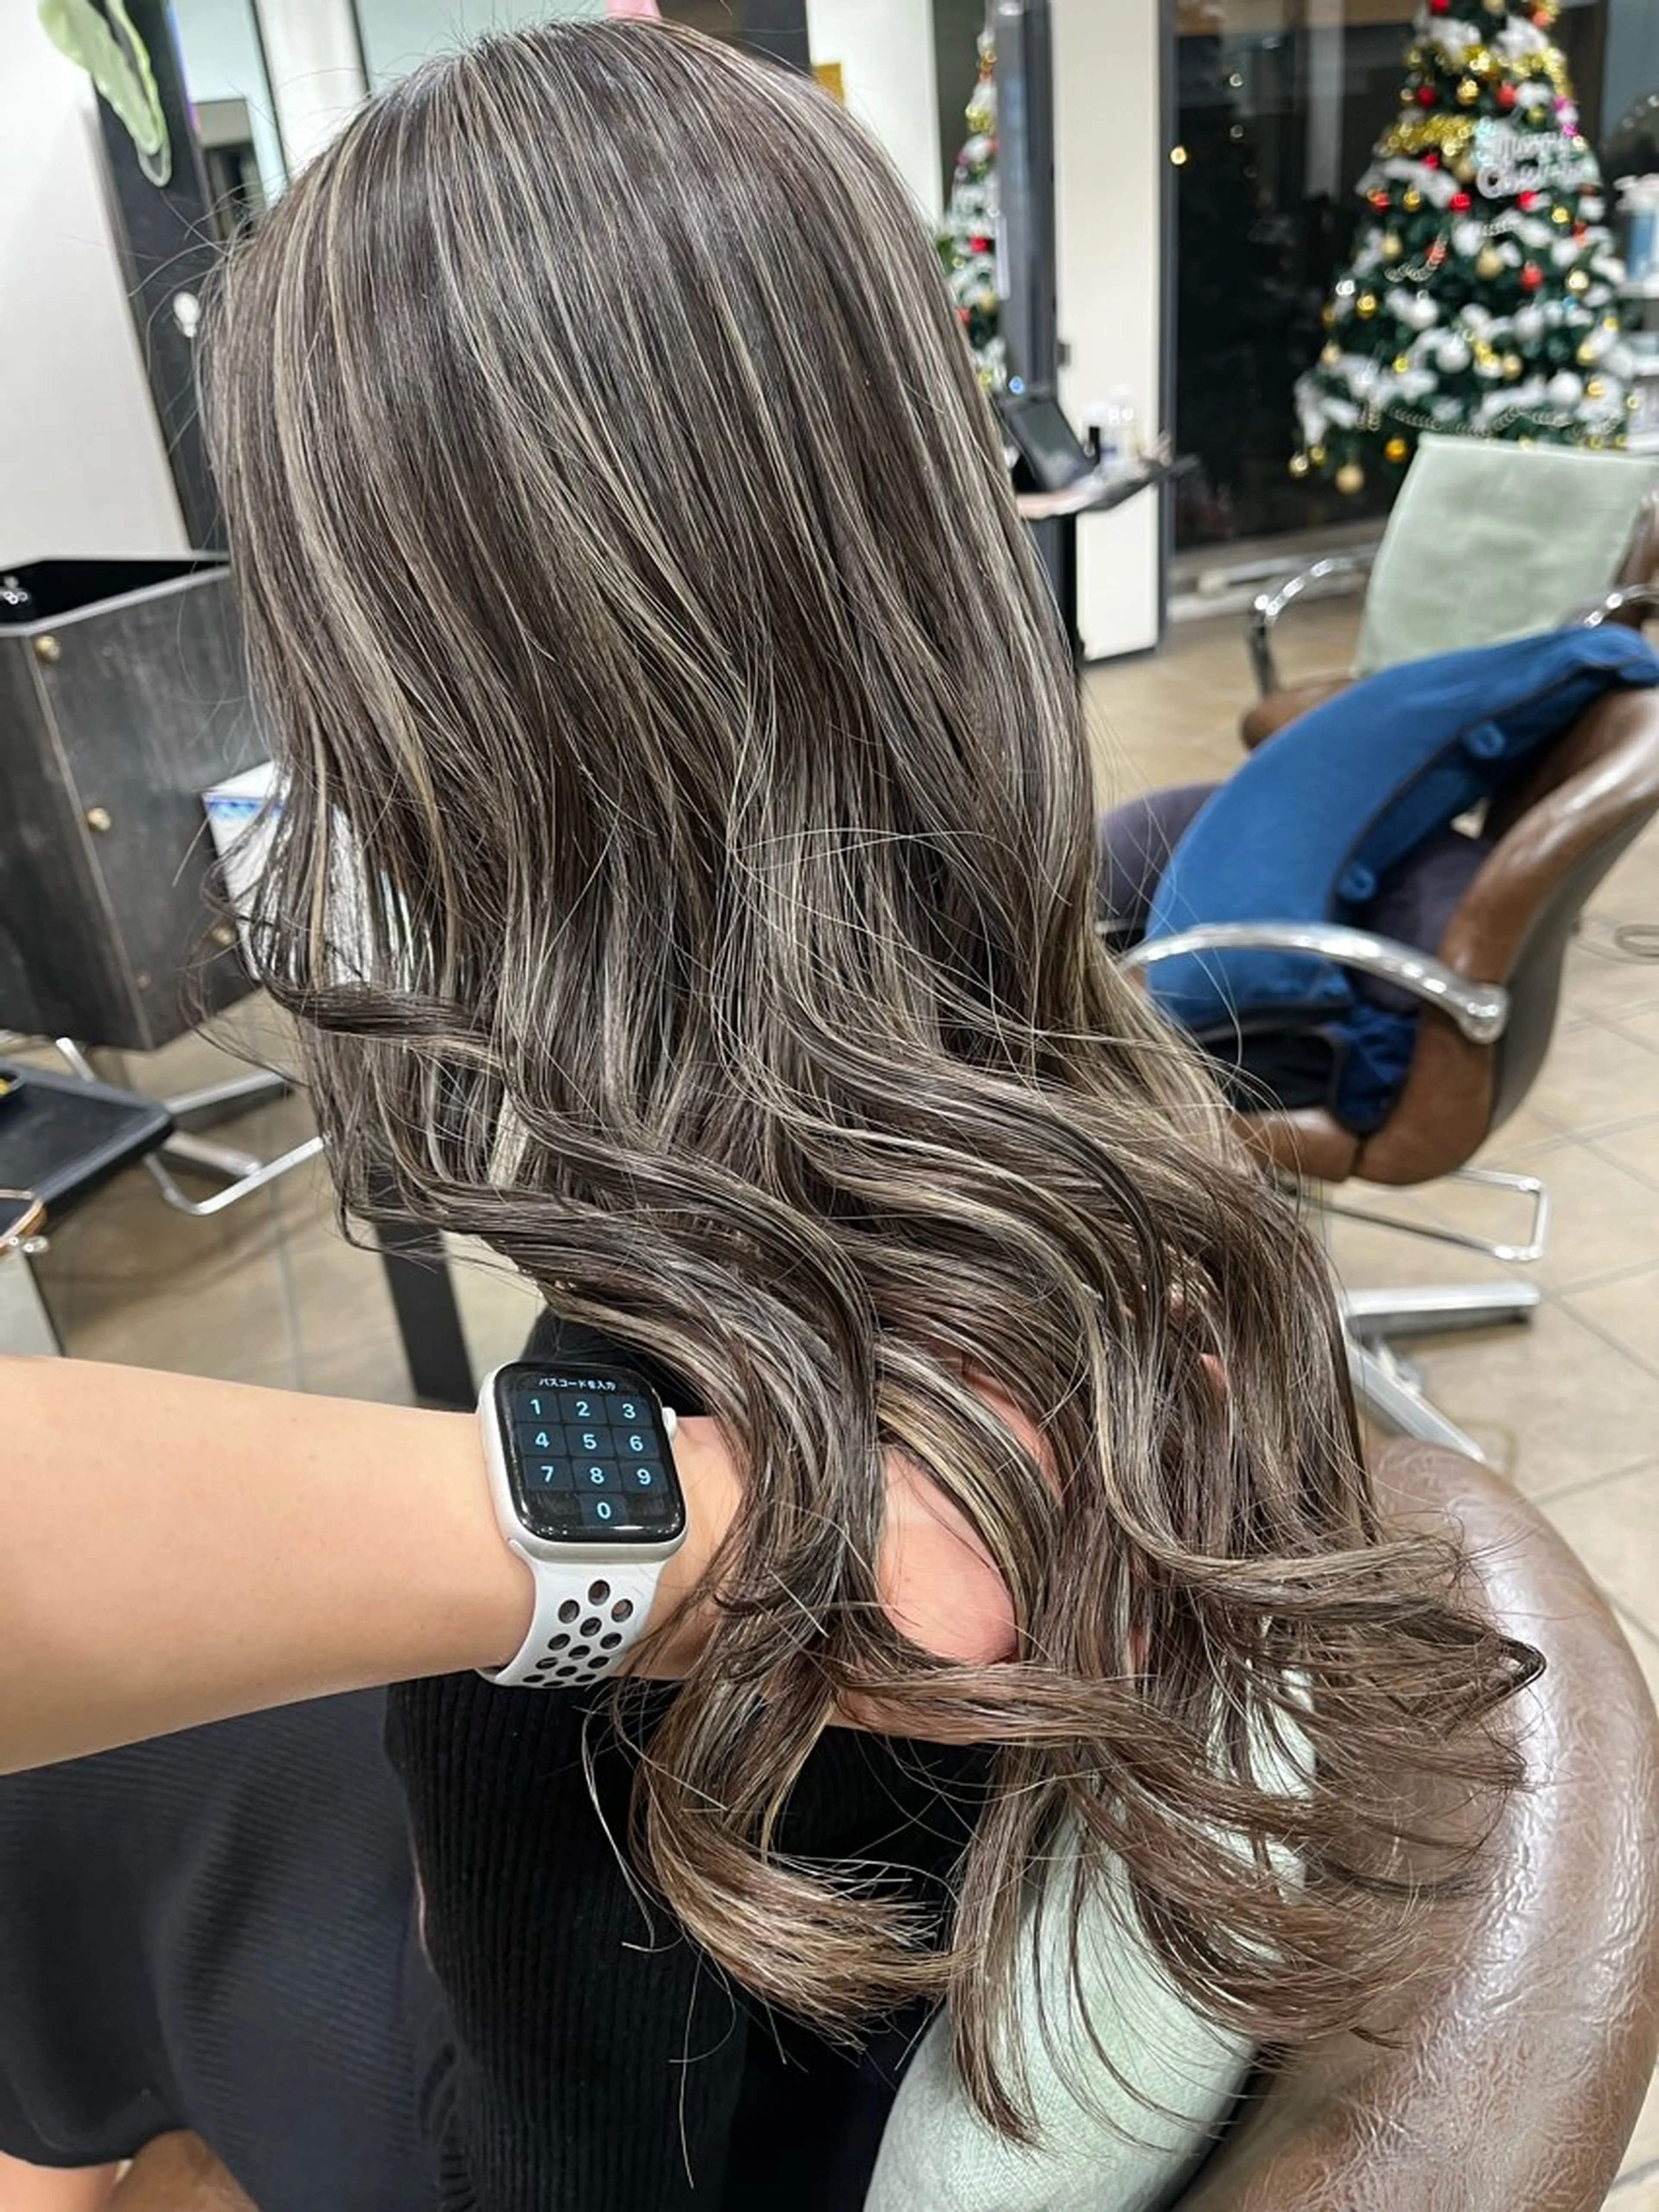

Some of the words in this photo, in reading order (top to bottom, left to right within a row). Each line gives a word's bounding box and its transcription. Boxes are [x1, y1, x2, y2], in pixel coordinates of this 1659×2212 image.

[531, 1399, 540, 1414] 1
[576, 1402, 590, 1416] 2
[623, 1404, 636, 1418] 3
[535, 1432, 549, 1447] 4
[583, 1434, 597, 1449] 5
[630, 1435, 643, 1451] 6
[541, 1466, 553, 1482] 7
[590, 1467, 604, 1484] 8
[637, 1468, 651, 1484] 9
[597, 1502, 611, 1519] 0
